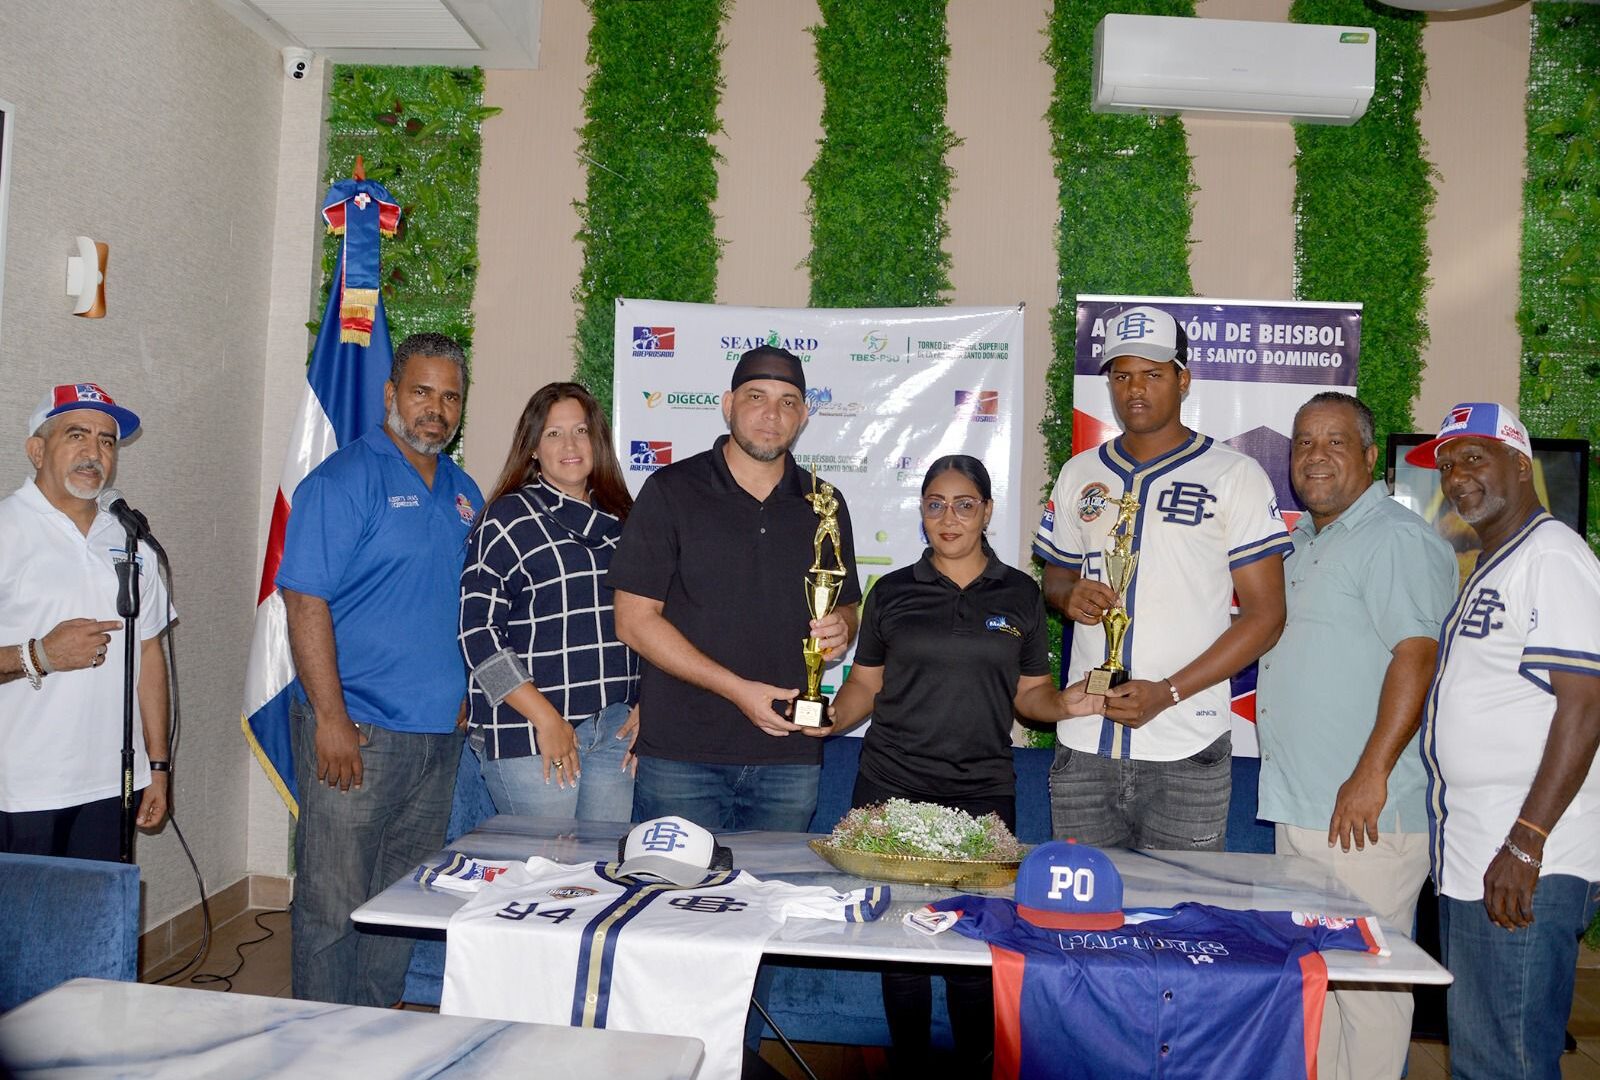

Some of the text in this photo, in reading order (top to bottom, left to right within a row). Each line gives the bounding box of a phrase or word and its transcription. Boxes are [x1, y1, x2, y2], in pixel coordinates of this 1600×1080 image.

[1225, 322, 1252, 342] DE
[1259, 323, 1344, 347] BEISBOL
[917, 341, 942, 350] TORNEO
[978, 342, 1009, 351] SUPERIOR
[982, 352, 1009, 360] DOMINGO
[1207, 347, 1257, 364] SANTO
[1263, 350, 1343, 368] DOMINGO
[667, 393, 720, 405] DIGECAC
[1047, 865, 1095, 902] PO
[1187, 954, 1214, 965] 14
